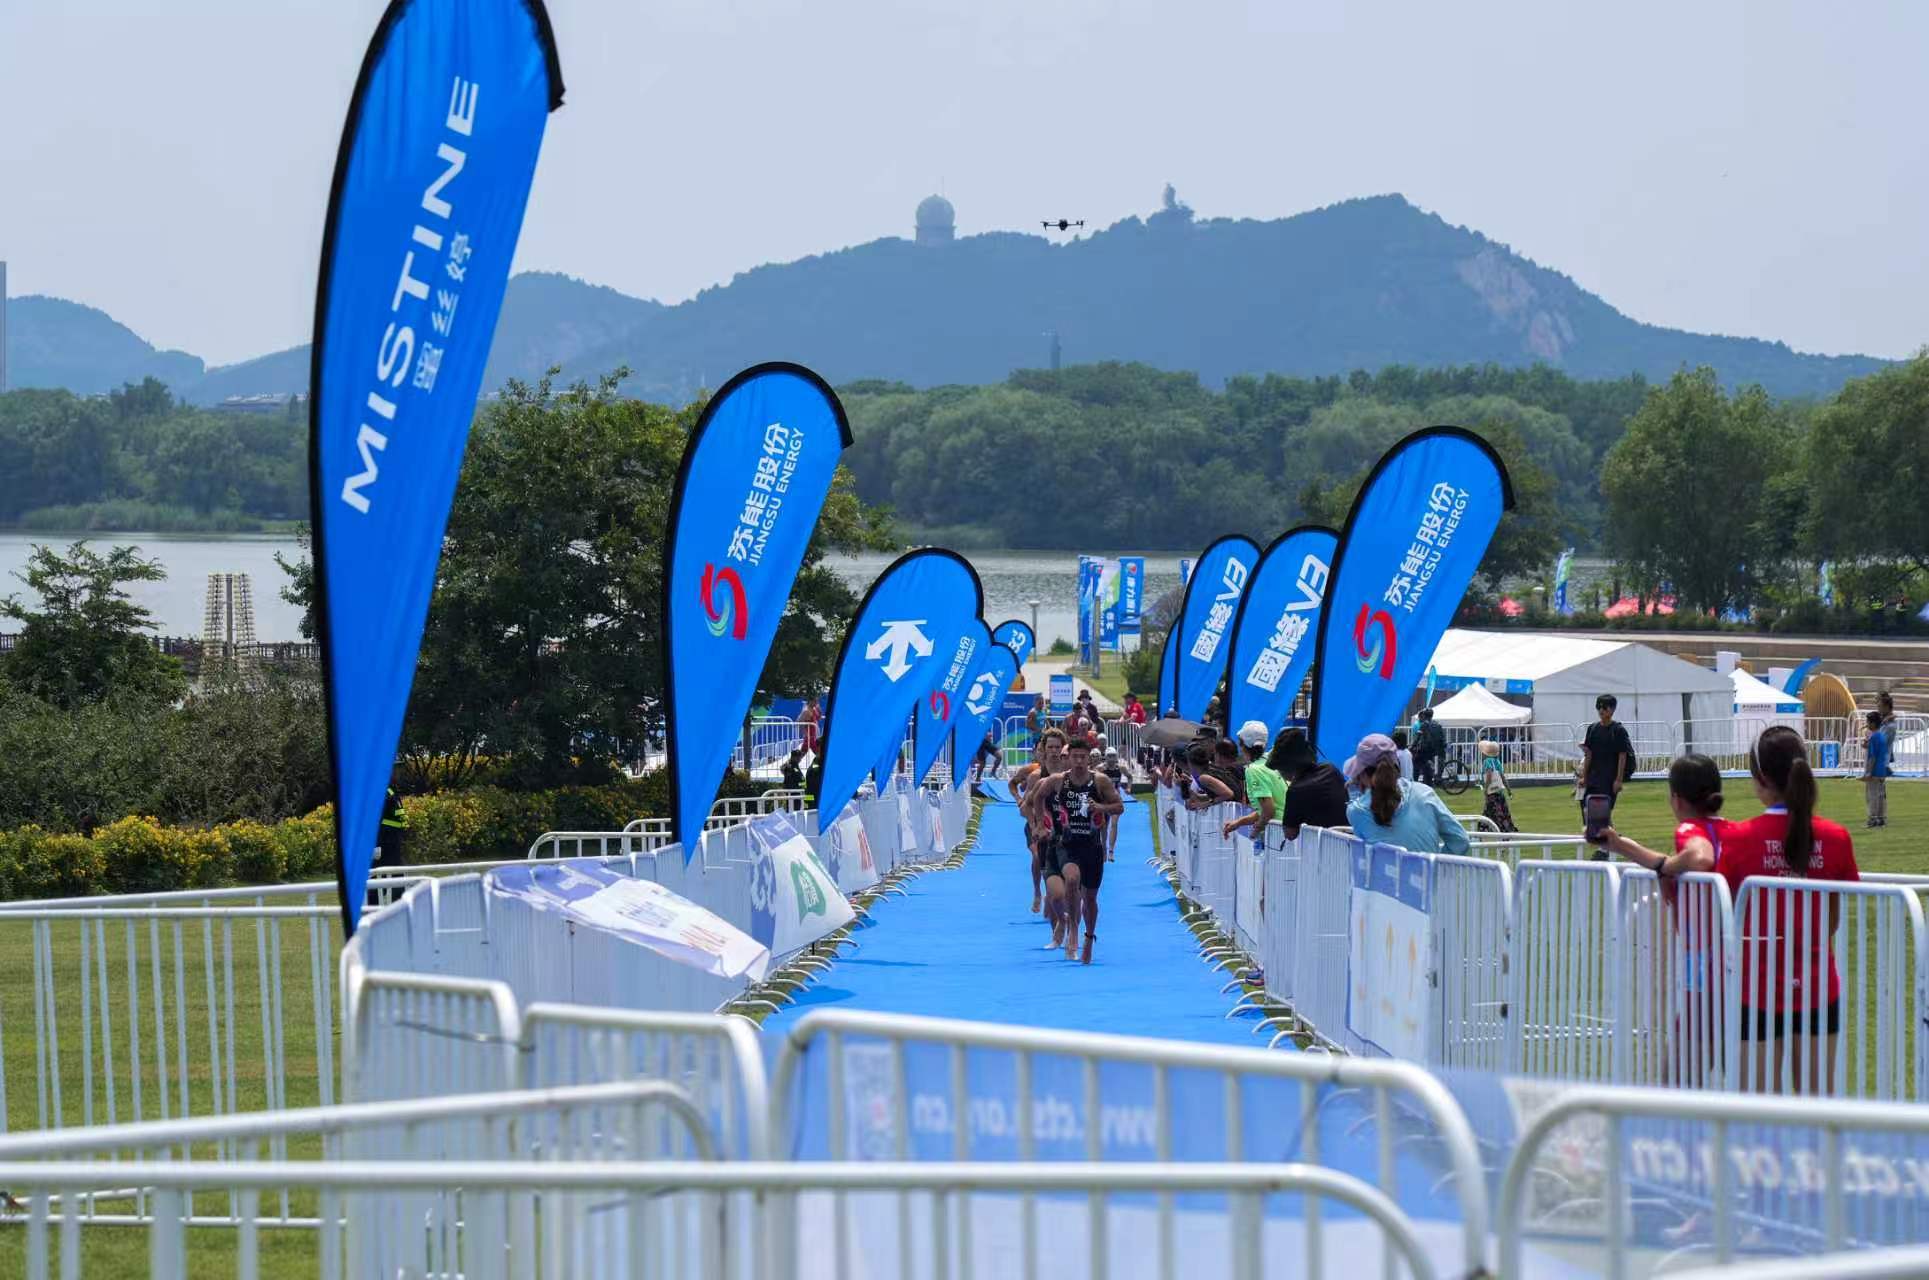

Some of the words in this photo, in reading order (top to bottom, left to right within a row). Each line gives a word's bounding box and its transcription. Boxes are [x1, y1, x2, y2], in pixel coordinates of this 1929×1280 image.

[341, 75, 480, 514] MISTINE
[727, 422, 790, 562] 苏能股份
[750, 497, 782, 567] JIANGSU
[776, 428, 804, 494] ENERGY
[1383, 481, 1456, 607] 苏能股份
[1403, 551, 1442, 613] JIANGSU
[1437, 488, 1470, 552] ENERGY
